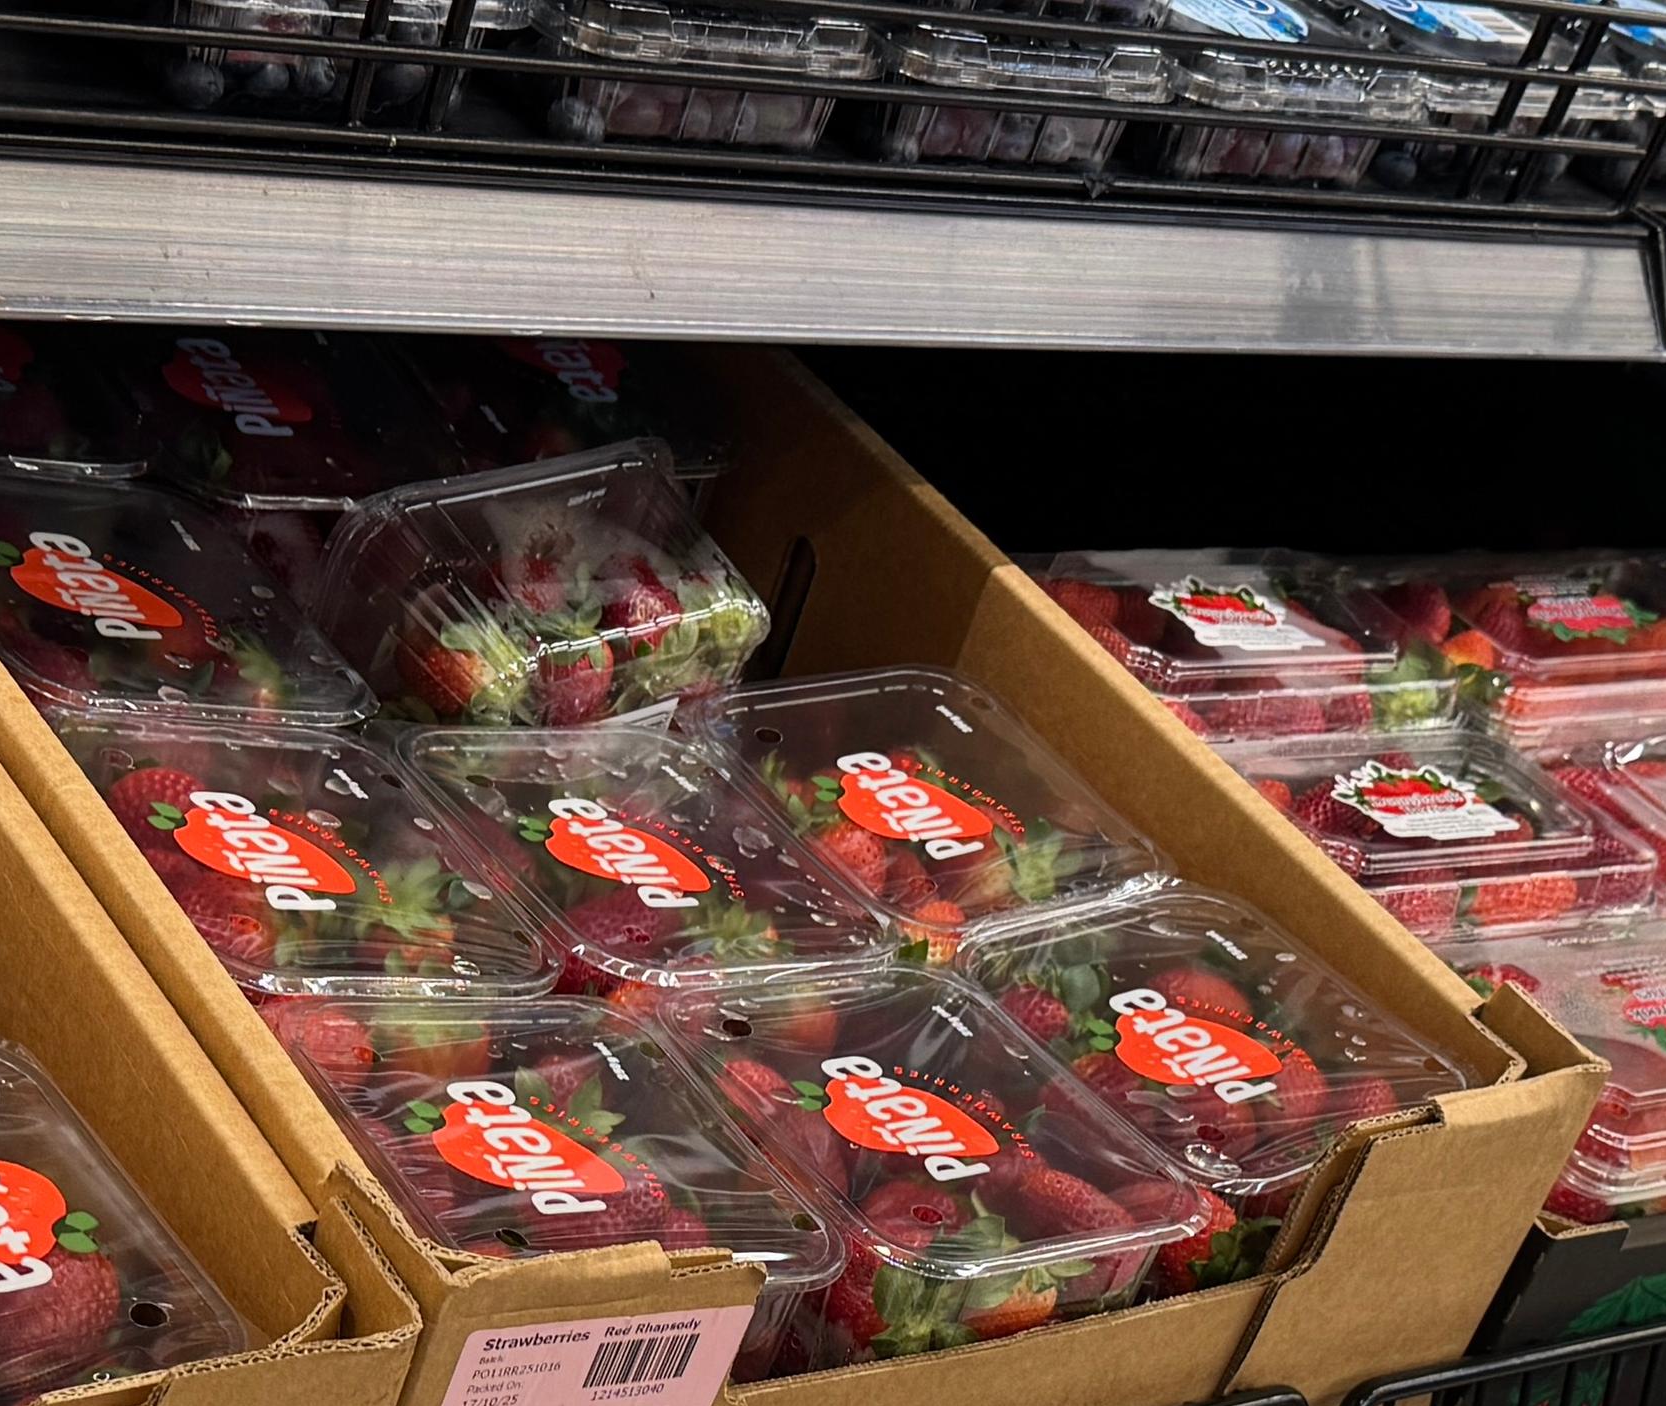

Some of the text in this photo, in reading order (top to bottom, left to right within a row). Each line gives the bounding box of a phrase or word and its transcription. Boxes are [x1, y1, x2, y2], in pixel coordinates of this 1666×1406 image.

[483, 1318, 702, 1351] Strawberries Red Rhapsody
[466, 1382, 504, 1395] Packed
[590, 1383, 665, 1402] 1214513040
